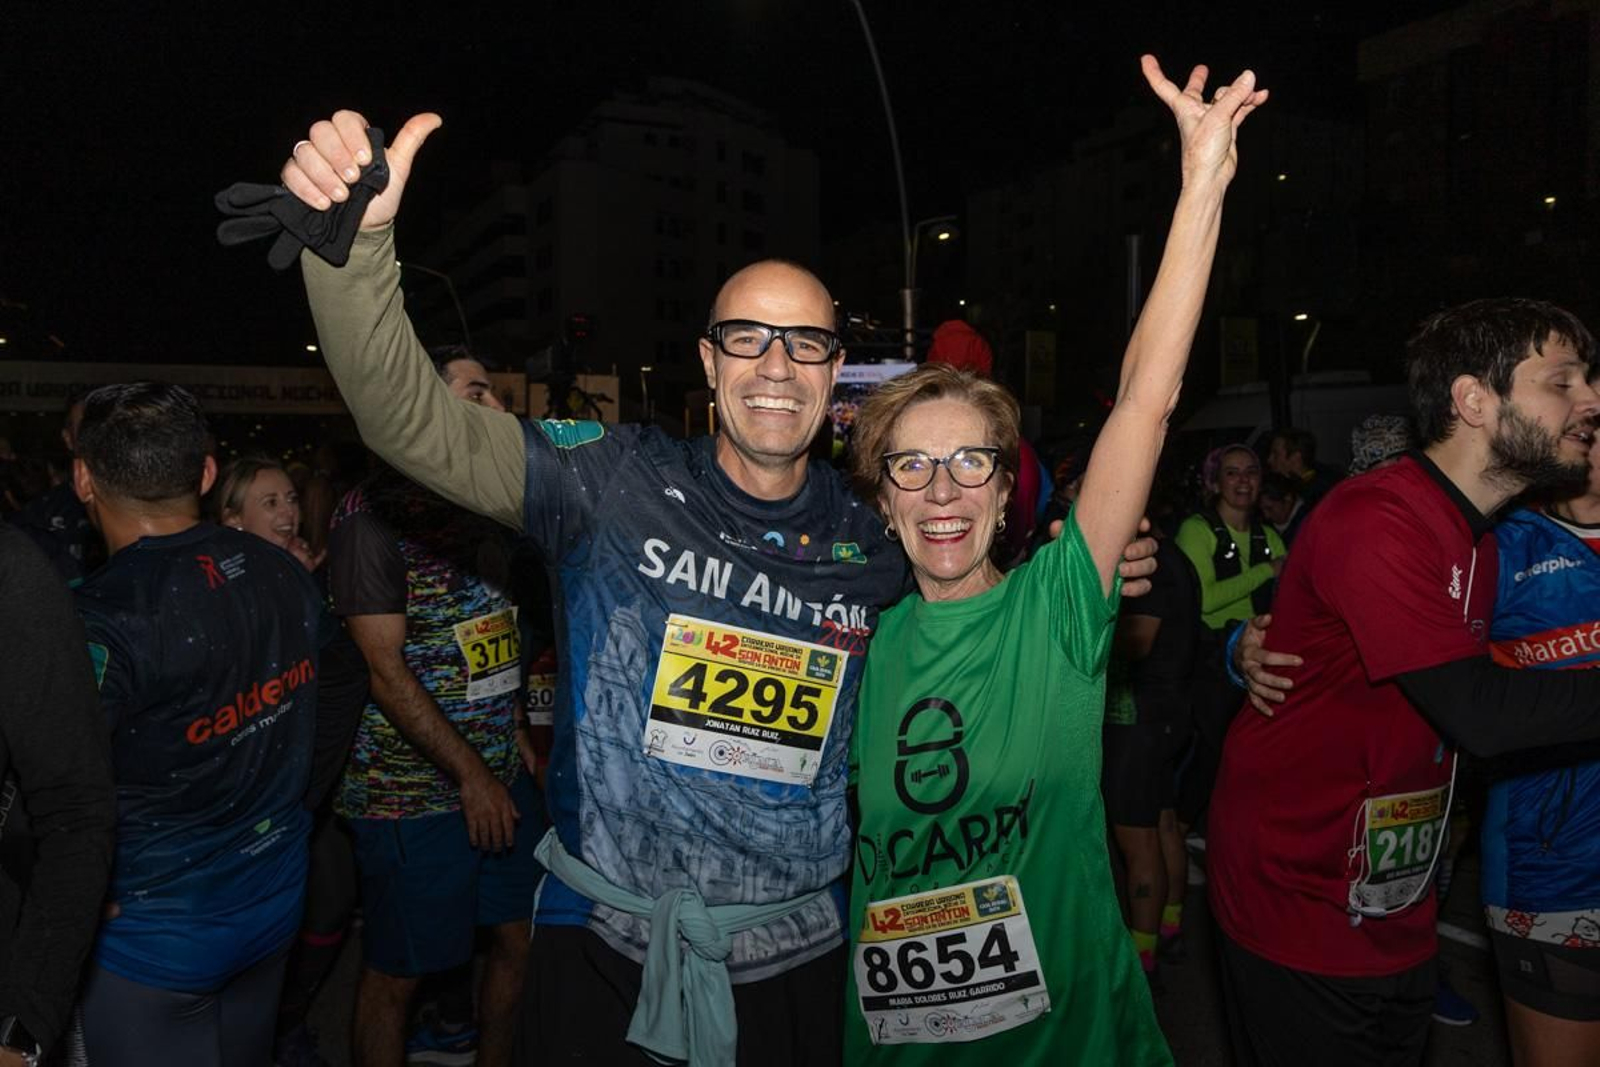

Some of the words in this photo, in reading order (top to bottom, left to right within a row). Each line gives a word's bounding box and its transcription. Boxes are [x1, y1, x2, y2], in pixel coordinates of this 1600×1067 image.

[638, 538, 733, 600] SAN
[740, 572, 869, 633] ANTÓN
[705, 631, 740, 659] 42
[738, 649, 761, 664] SAN
[667, 662, 822, 732] 4295
[705, 719, 740, 734] JONATAN
[741, 725, 760, 737] RUIZ
[870, 907, 905, 933] 42
[863, 922, 1020, 994] 8654
[914, 993, 947, 1004] DOLORES
[948, 990, 969, 1000] RUIZ
[970, 982, 1006, 997] GARRIDO
